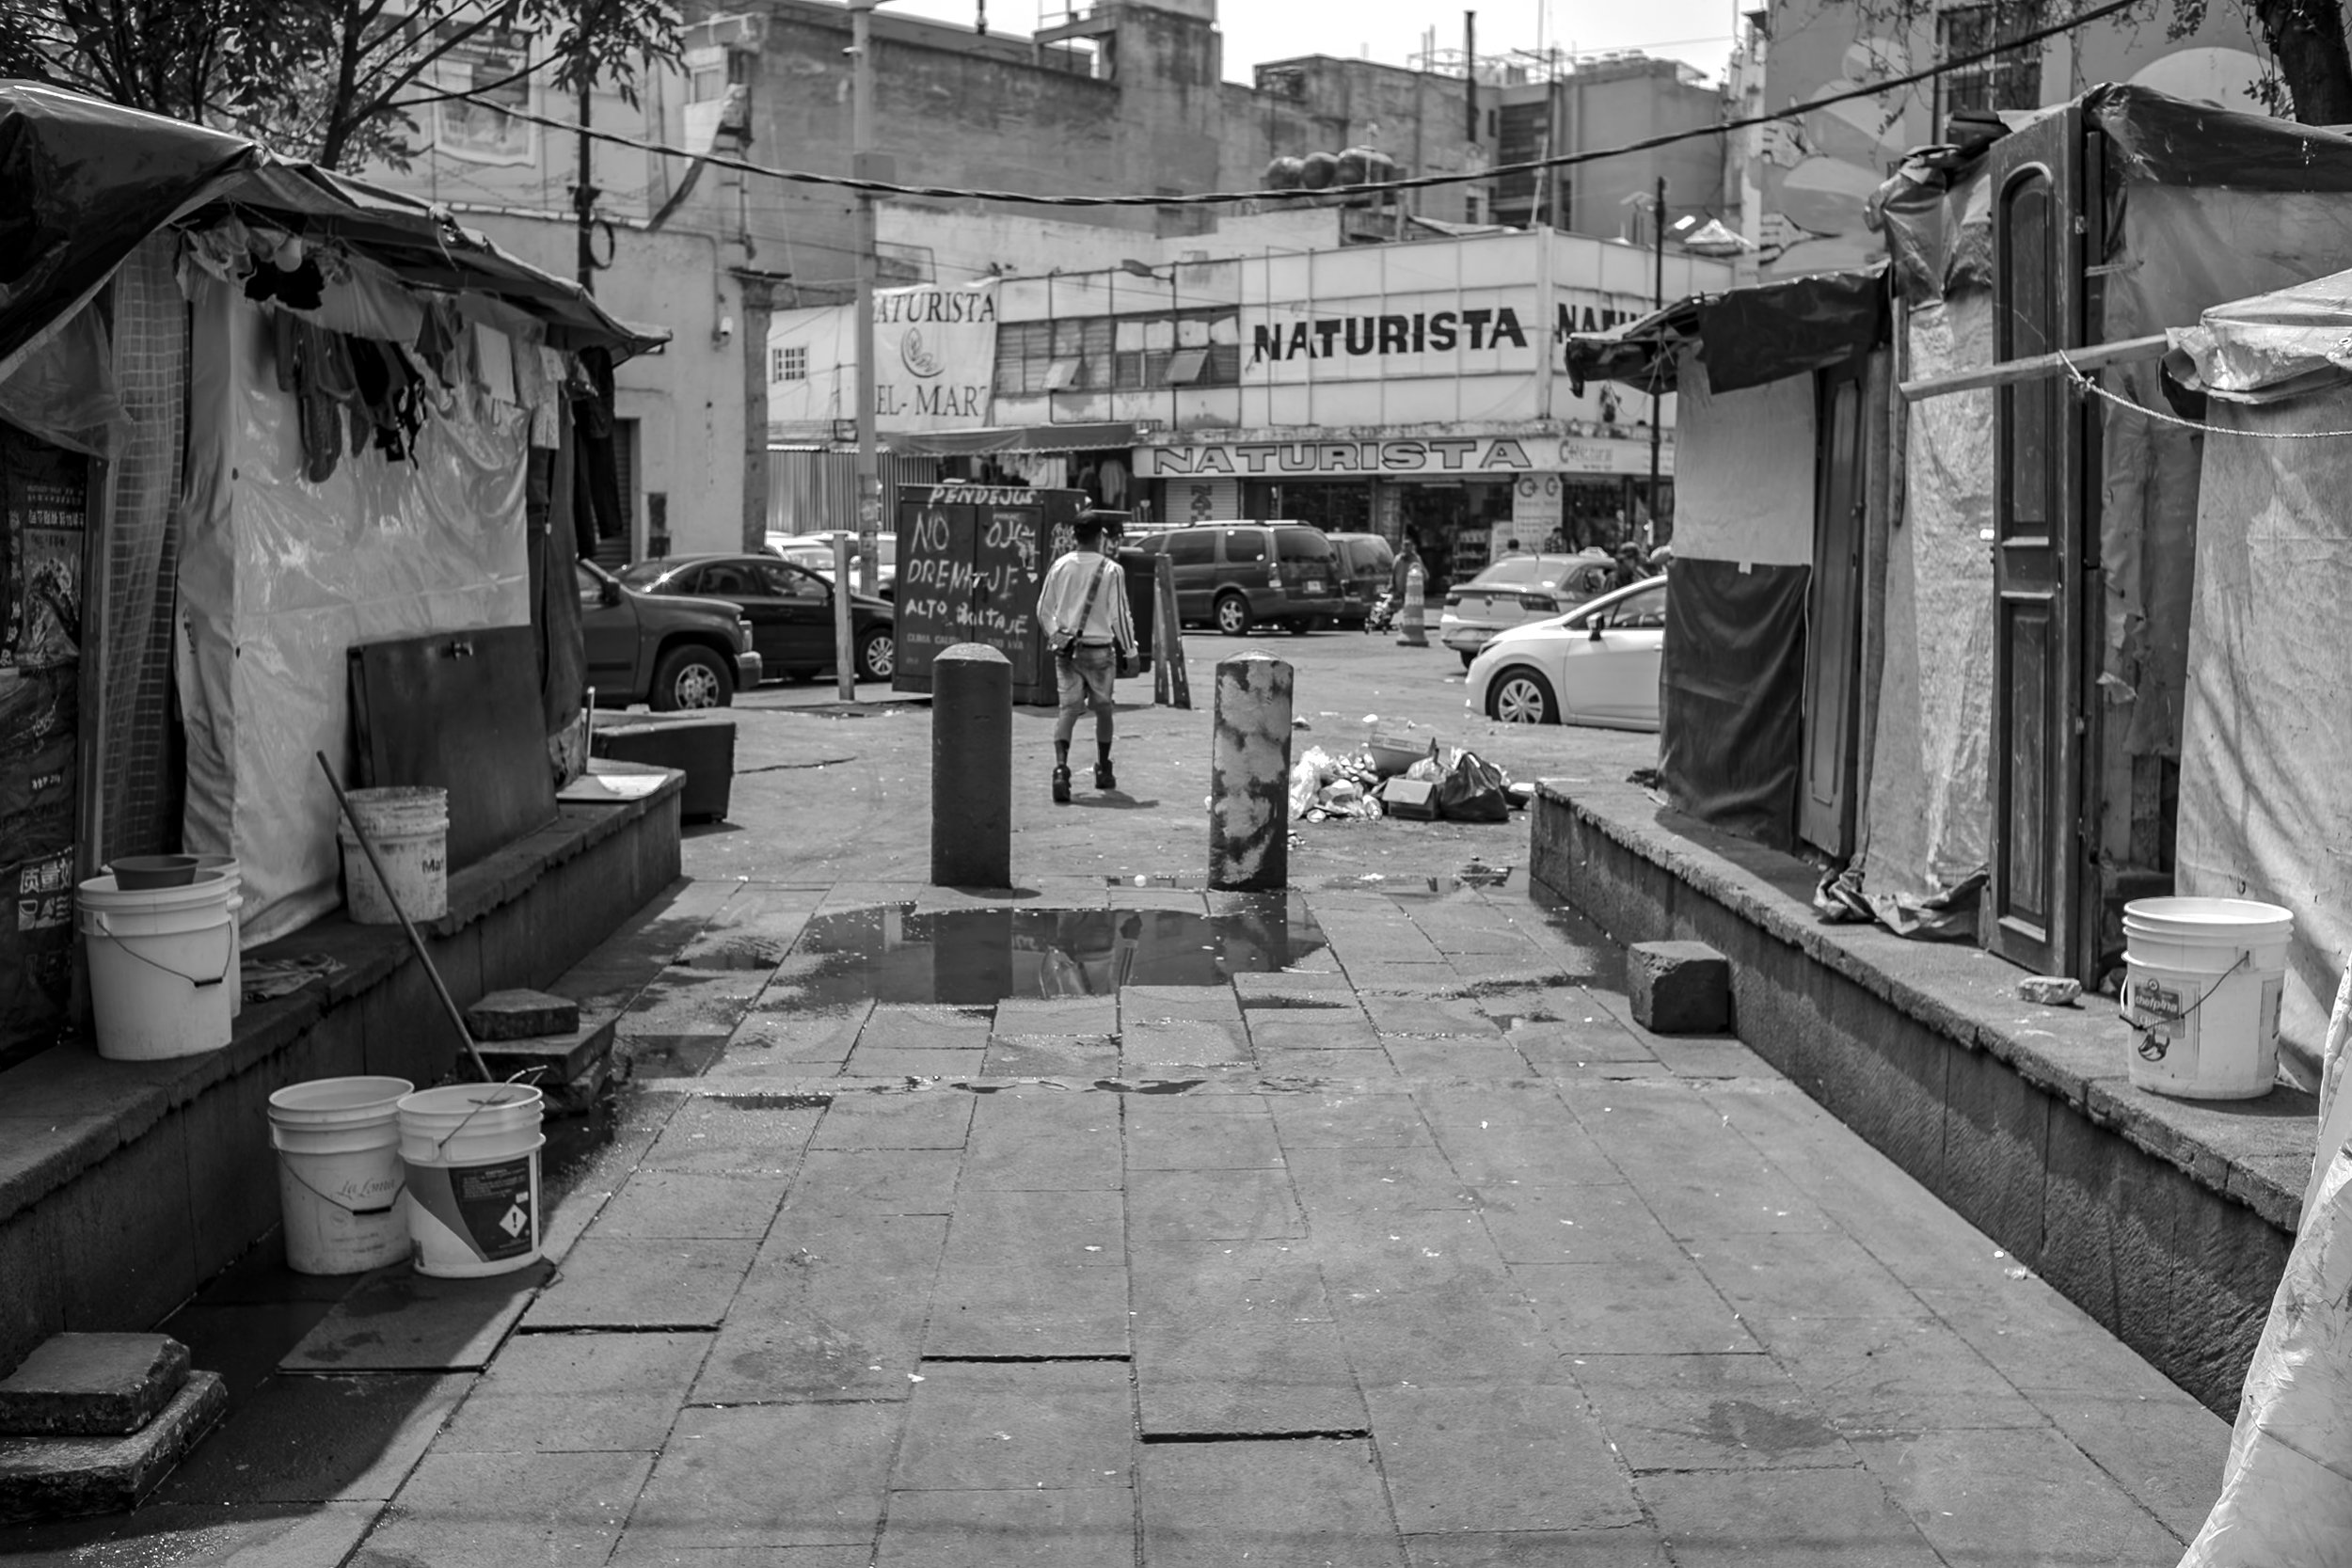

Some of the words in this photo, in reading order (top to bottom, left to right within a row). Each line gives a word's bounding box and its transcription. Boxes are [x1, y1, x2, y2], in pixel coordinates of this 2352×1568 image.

[874, 292, 995, 323] ATURISTA
[1254, 308, 1528, 363] NATURISTA
[1153, 439, 1533, 473] NATURISTA
[912, 512, 949, 553] NO
[905, 598, 947, 619] ALTO
